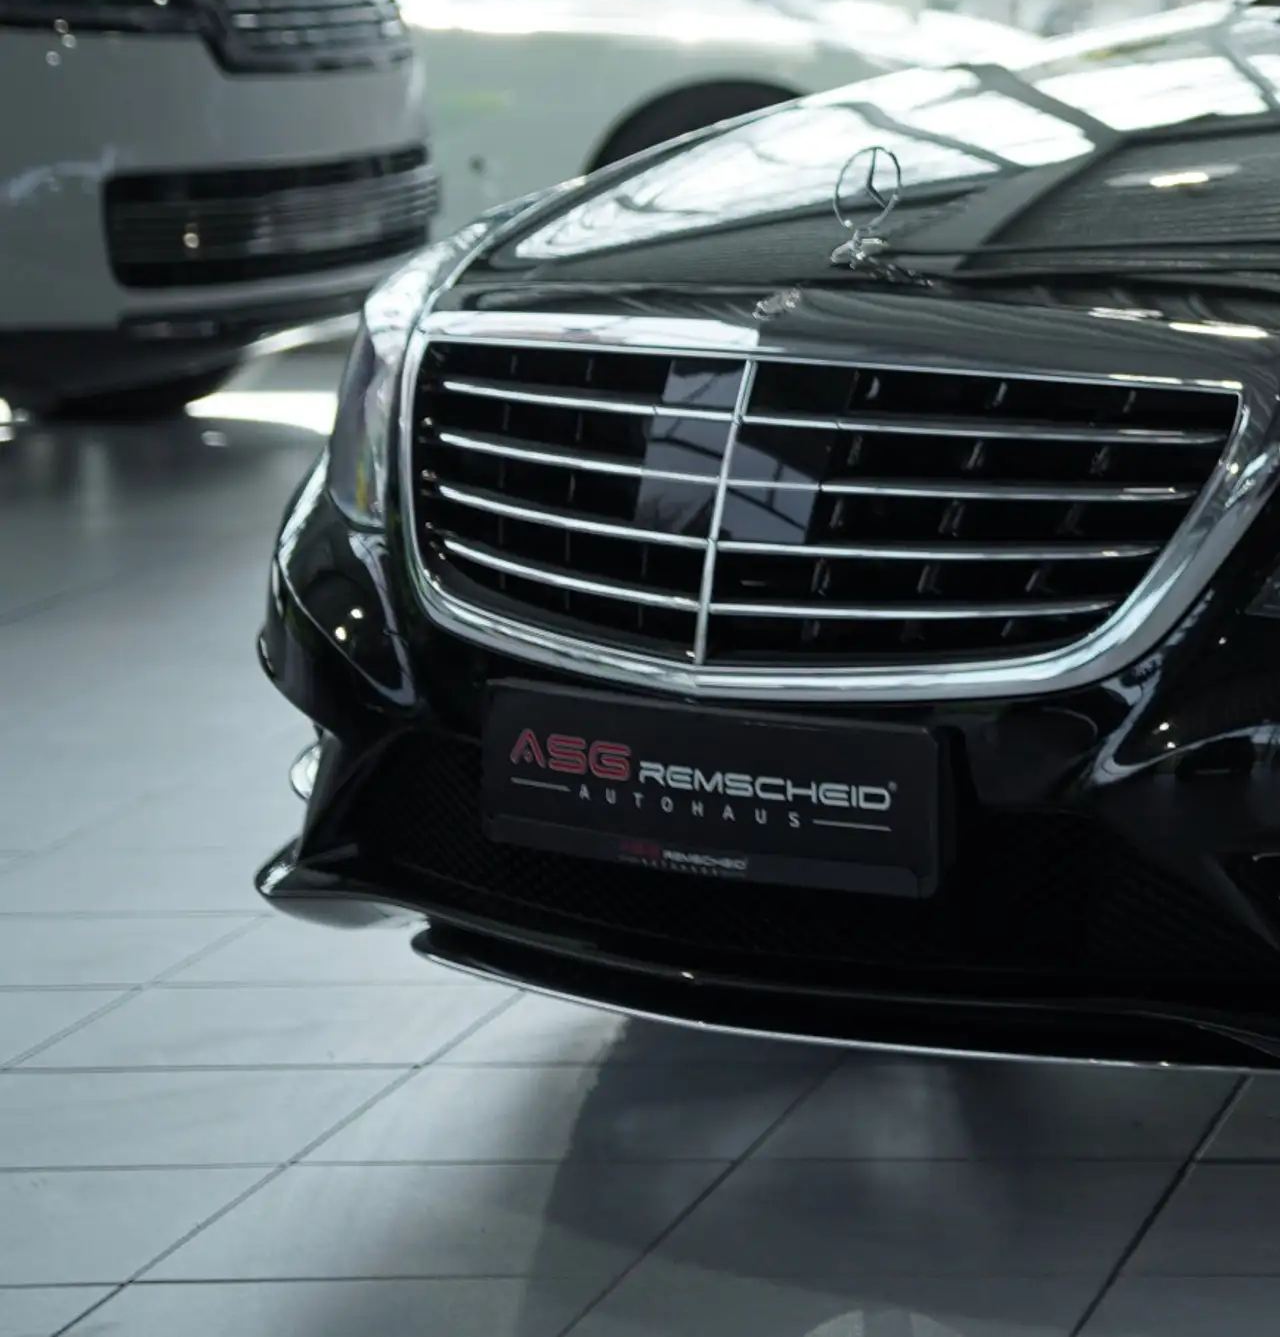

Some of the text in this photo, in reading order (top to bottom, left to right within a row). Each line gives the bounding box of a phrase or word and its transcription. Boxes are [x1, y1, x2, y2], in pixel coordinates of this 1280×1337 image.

[510, 727, 892, 812] ASG REMSCHEID
[579, 783, 801, 828] AUTOHAUS
